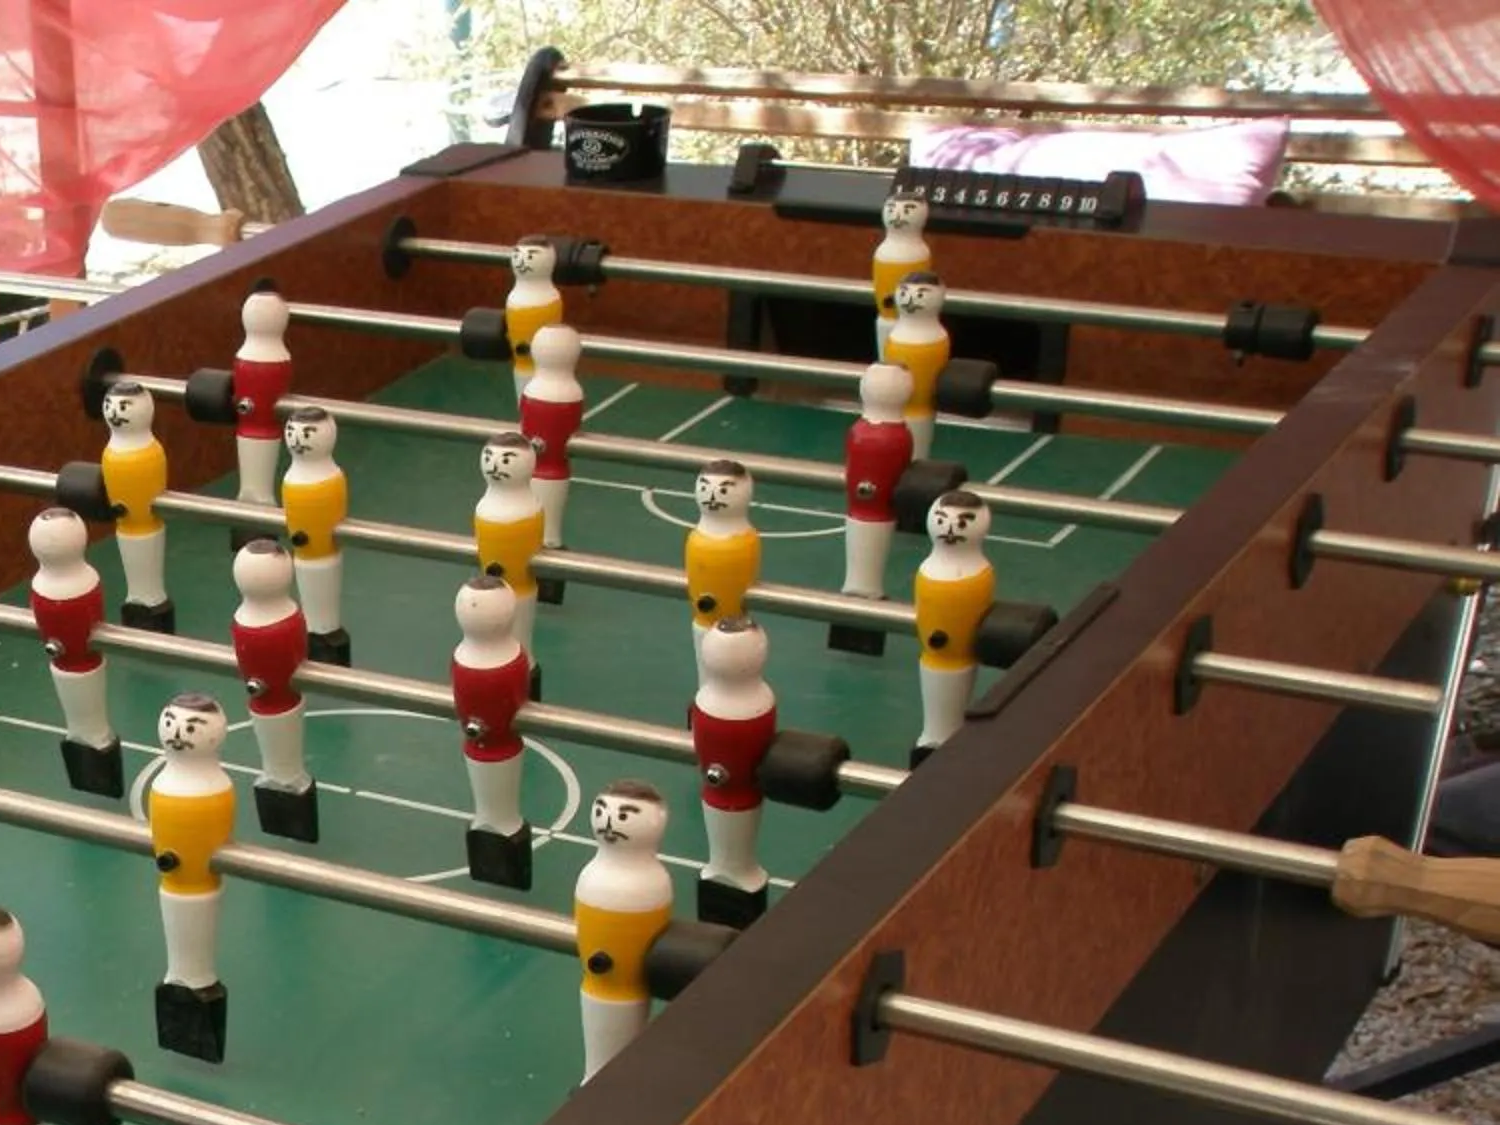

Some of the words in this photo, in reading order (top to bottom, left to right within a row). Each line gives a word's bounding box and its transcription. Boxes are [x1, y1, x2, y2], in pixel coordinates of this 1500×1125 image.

[933, 186, 946, 203] 3
[954, 189, 967, 204] 4
[975, 189, 988, 205] 5
[996, 192, 1008, 206] 6
[1019, 192, 1031, 207] 7
[1038, 193, 1051, 208] 8
[1060, 195, 1072, 211] 9
[1078, 197, 1097, 213] 10
